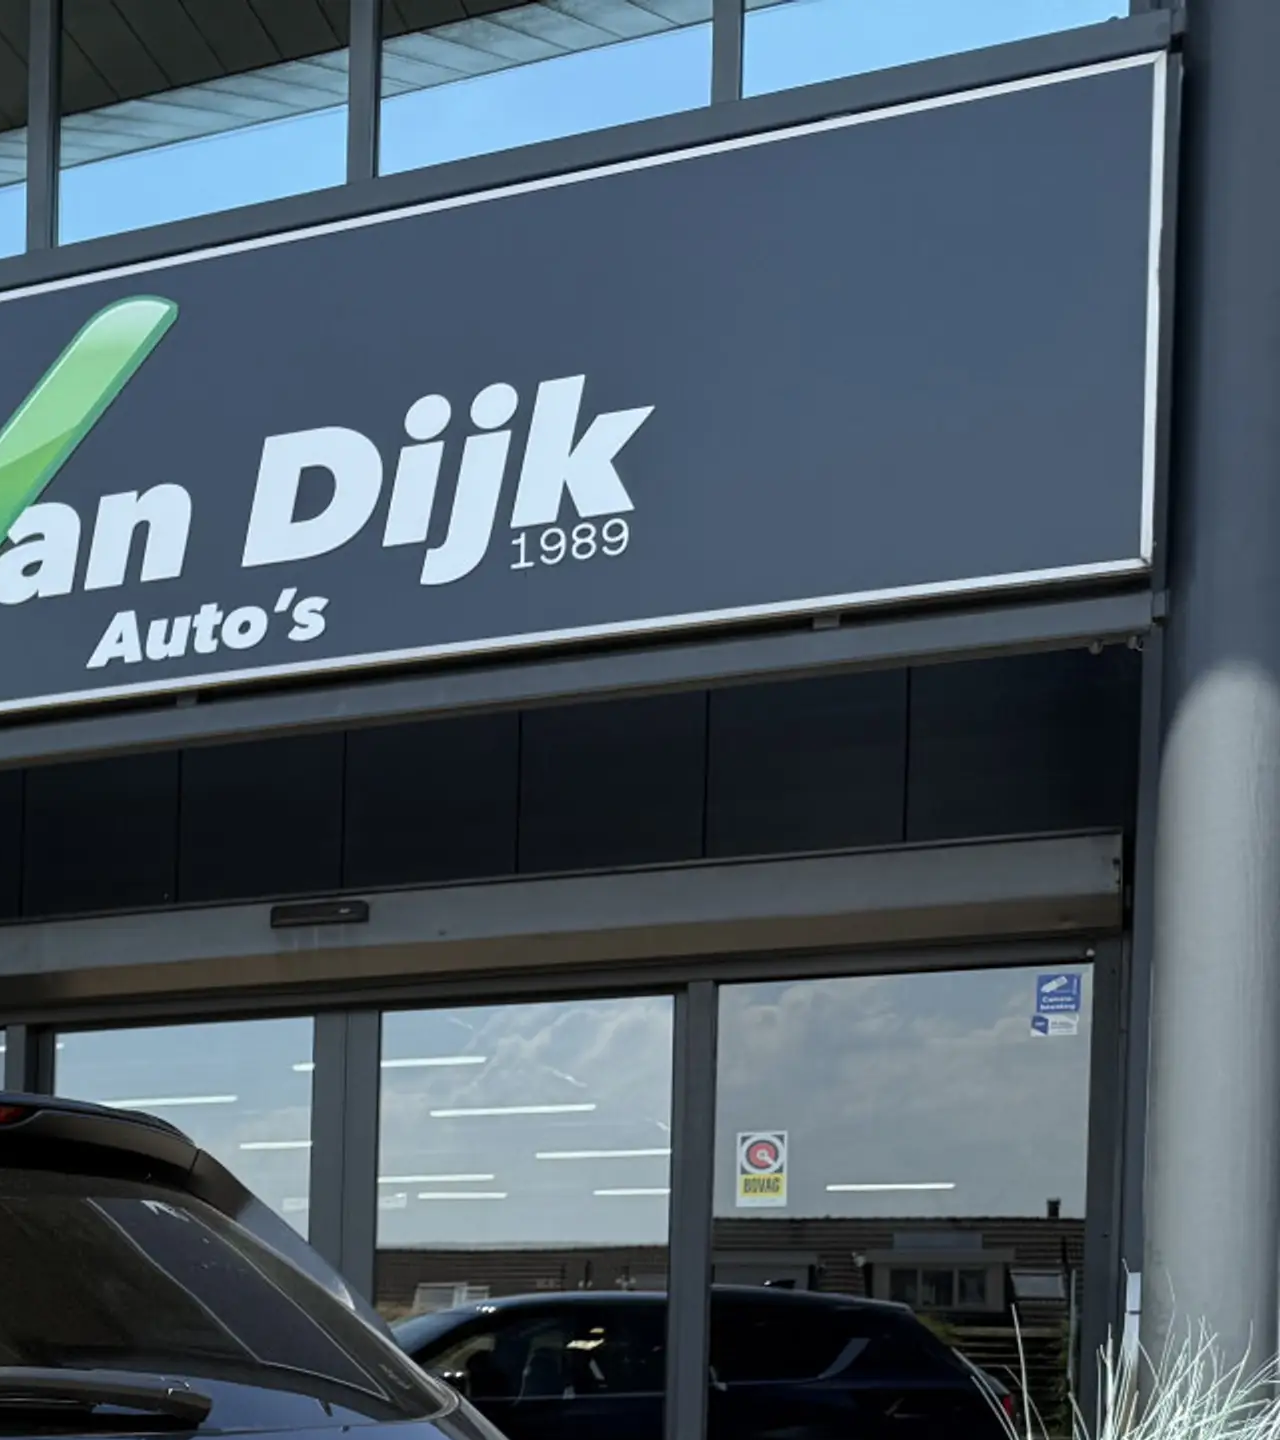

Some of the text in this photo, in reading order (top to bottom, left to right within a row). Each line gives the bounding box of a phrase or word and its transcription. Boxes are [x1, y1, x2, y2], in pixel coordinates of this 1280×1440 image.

[241, 373, 655, 586] Dijk
[509, 518, 632, 572] 1989
[85, 587, 330, 670] Auto's
[743, 1177, 781, 1194] BOVAG
